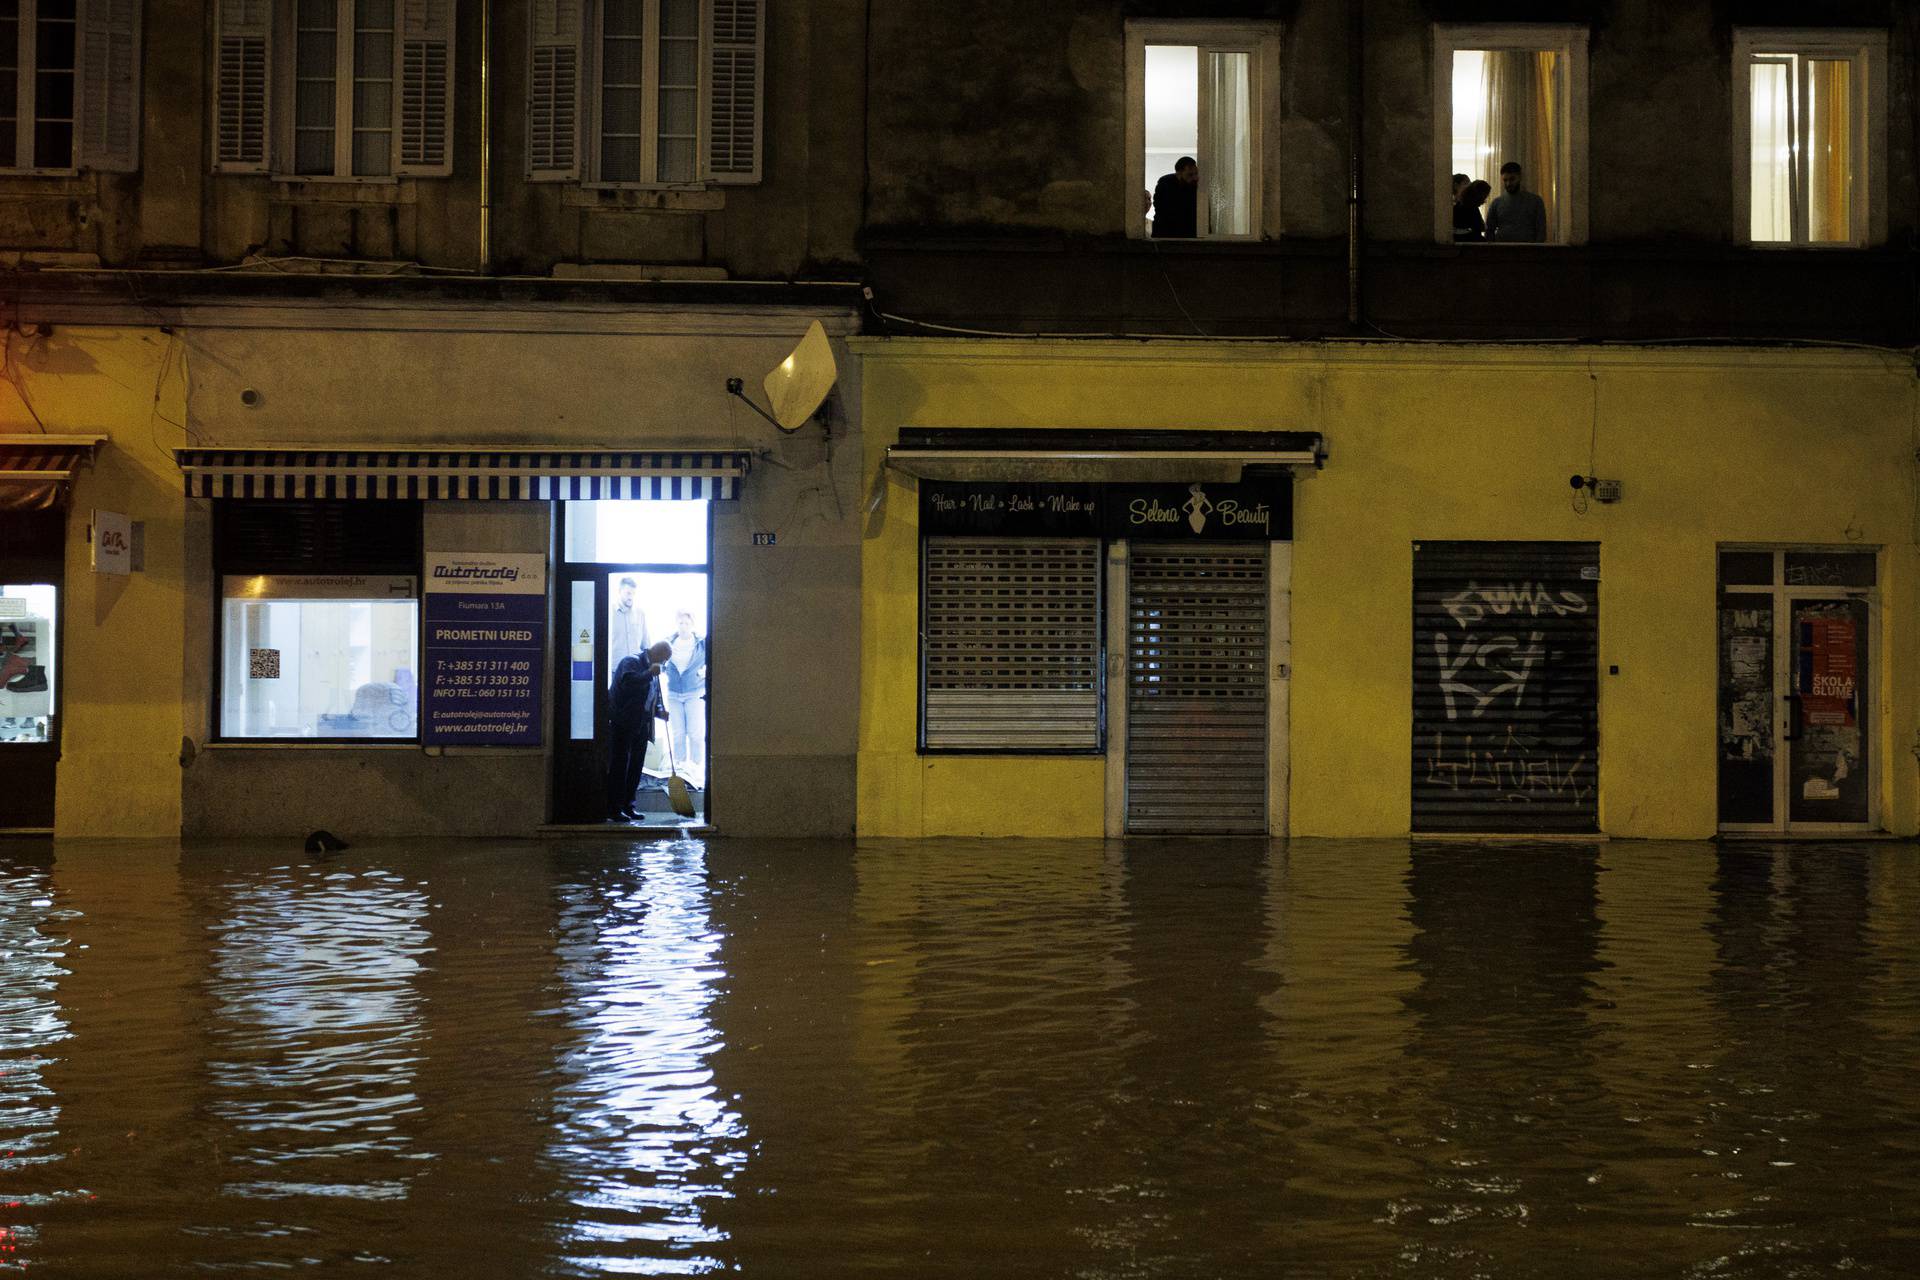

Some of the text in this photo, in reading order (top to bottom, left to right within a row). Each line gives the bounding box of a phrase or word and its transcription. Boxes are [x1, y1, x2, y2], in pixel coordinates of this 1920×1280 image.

[931, 493, 1096, 516] Hair Nail Lash Make up
[1129, 498, 1272, 536] Selena Beauty
[458, 601, 505, 610] Fiumara 13A
[436, 630, 532, 641] PROMETNI URED
[437, 660, 530, 671] T: +385 51 311 400
[436, 675, 529, 685] F: +385 51 330 330
[433, 689, 530, 698] INFO TEL.: 060 151 151
[1812, 687, 1853, 696] GLUME
[434, 723, 528, 735] www.autotrolej.hr
